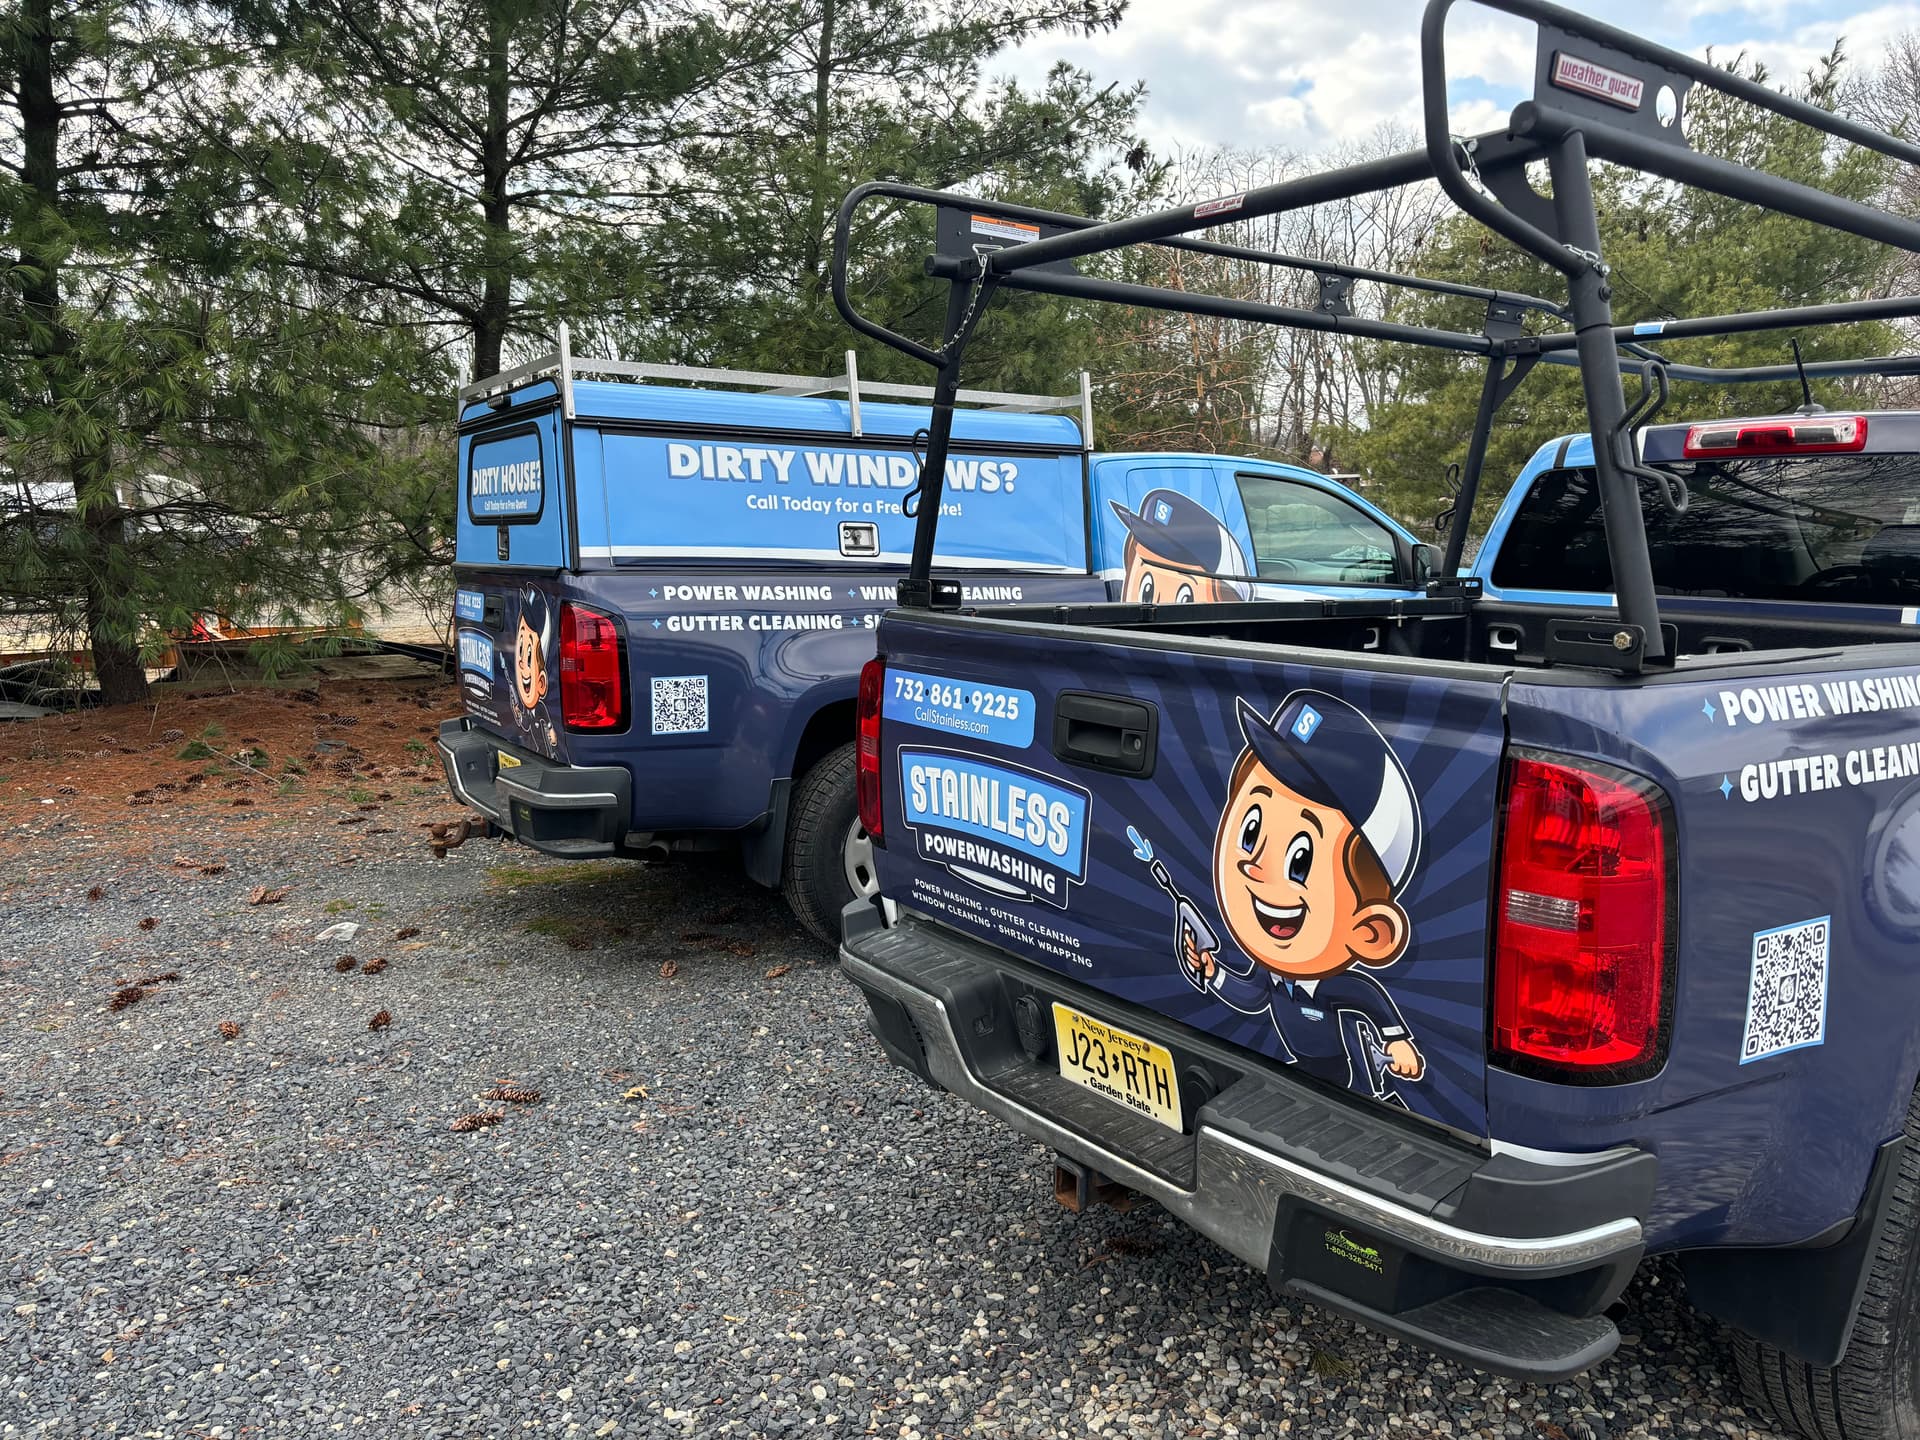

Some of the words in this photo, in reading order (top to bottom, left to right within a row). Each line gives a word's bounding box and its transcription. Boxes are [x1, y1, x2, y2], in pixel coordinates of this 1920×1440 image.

[1560, 59, 1608, 89] weather
[1608, 77, 1641, 100] guard
[472, 466, 500, 497] DIRTY
[501, 459, 541, 494] HOUSE?
[667, 443, 795, 483] DIRTY
[804, 451, 1019, 493] WINDWS?
[746, 494, 778, 511] Call
[782, 496, 831, 515] Today
[835, 498, 858, 513] for
[863, 502, 872, 514] a
[1157, 505, 1168, 521] S
[663, 586, 737, 600] POWER
[742, 587, 832, 600] WASHING
[860, 586, 897, 600] WIN
[667, 616, 744, 631] GUTTER
[748, 615, 843, 630] CLEANING
[460, 637, 491, 673] STAINLESS
[914, 706, 989, 735] CallStainless.com
[1297, 711, 1314, 736] S
[1719, 684, 1825, 726] POWER
[1740, 753, 1841, 803] GUTTER
[1845, 742, 1920, 786] CLEAN
[910, 765, 1070, 856] STAINLESS
[924, 833, 1056, 895] POWERWASHING
[912, 890, 945, 910] WINDOW
[947, 904, 991, 928] CLEANING
[998, 924, 1035, 946] SHRINK
[1037, 939, 1093, 968] WRAPPING
[915, 878, 941, 895] POWER
[943, 888, 982, 911] WASHING
[990, 907, 1025, 928] GUTTER
[1028, 921, 1080, 948] CLEANING
[1081, 1017, 1106, 1037] New
[1107, 1029, 1141, 1054] Jersey
[1090, 1077, 1123, 1101] Garden
[1126, 1094, 1151, 1114] State
